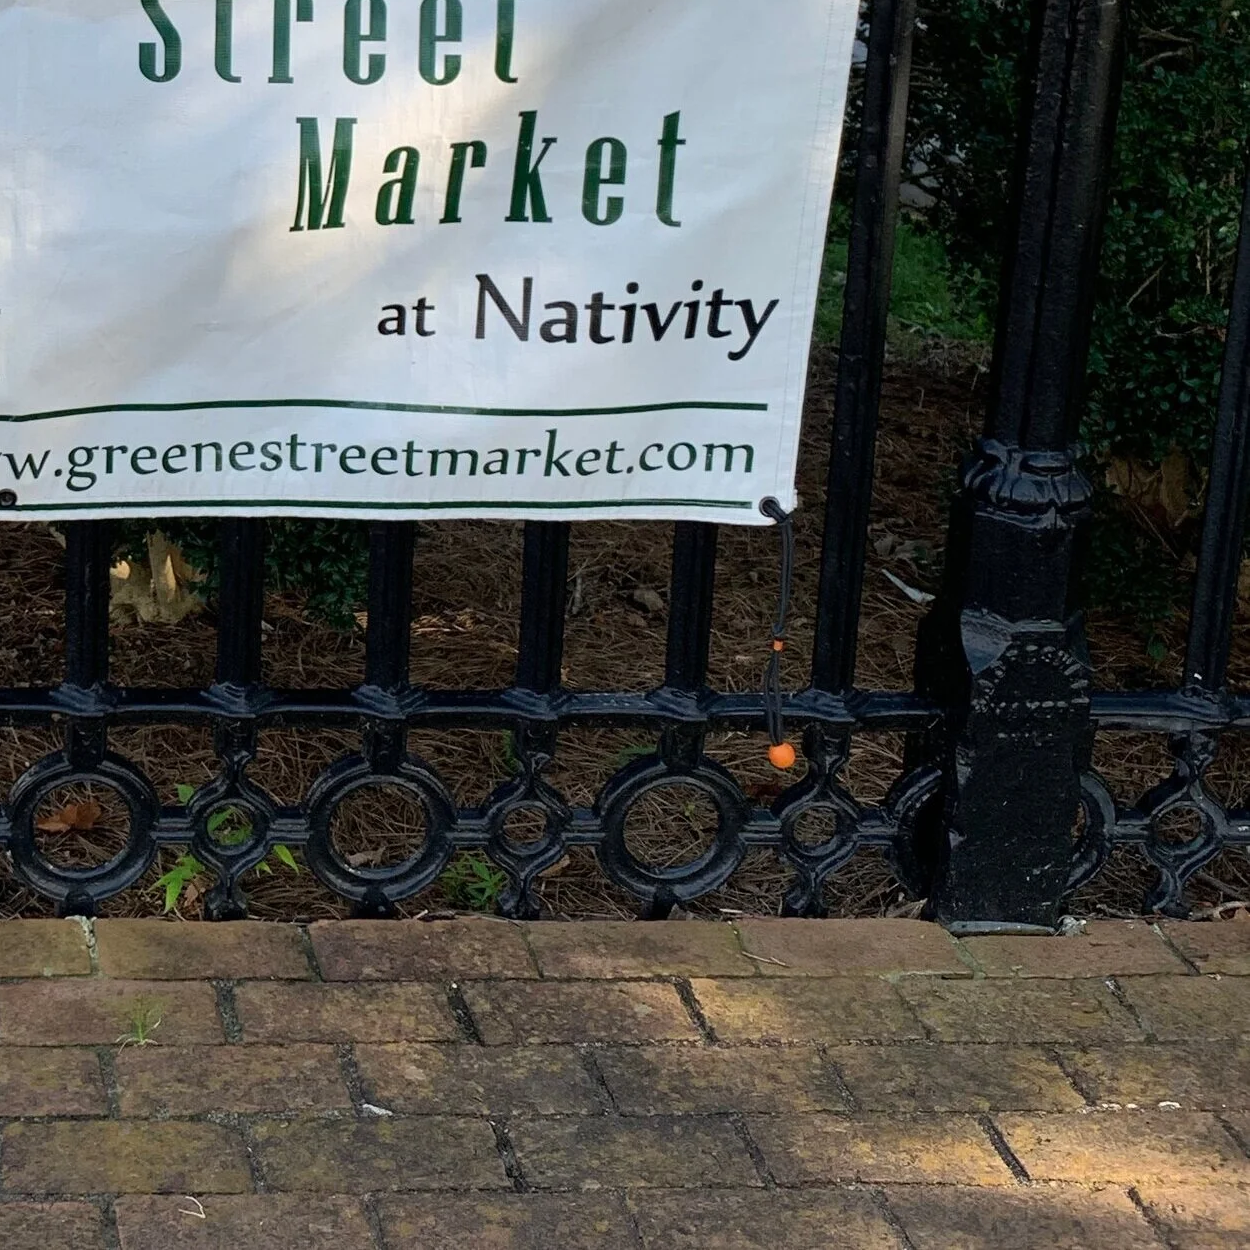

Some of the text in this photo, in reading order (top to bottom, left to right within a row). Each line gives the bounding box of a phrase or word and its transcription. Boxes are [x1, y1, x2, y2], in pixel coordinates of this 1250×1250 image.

[290, 110, 686, 232] Market
[378, 274, 780, 361] at Nativity
